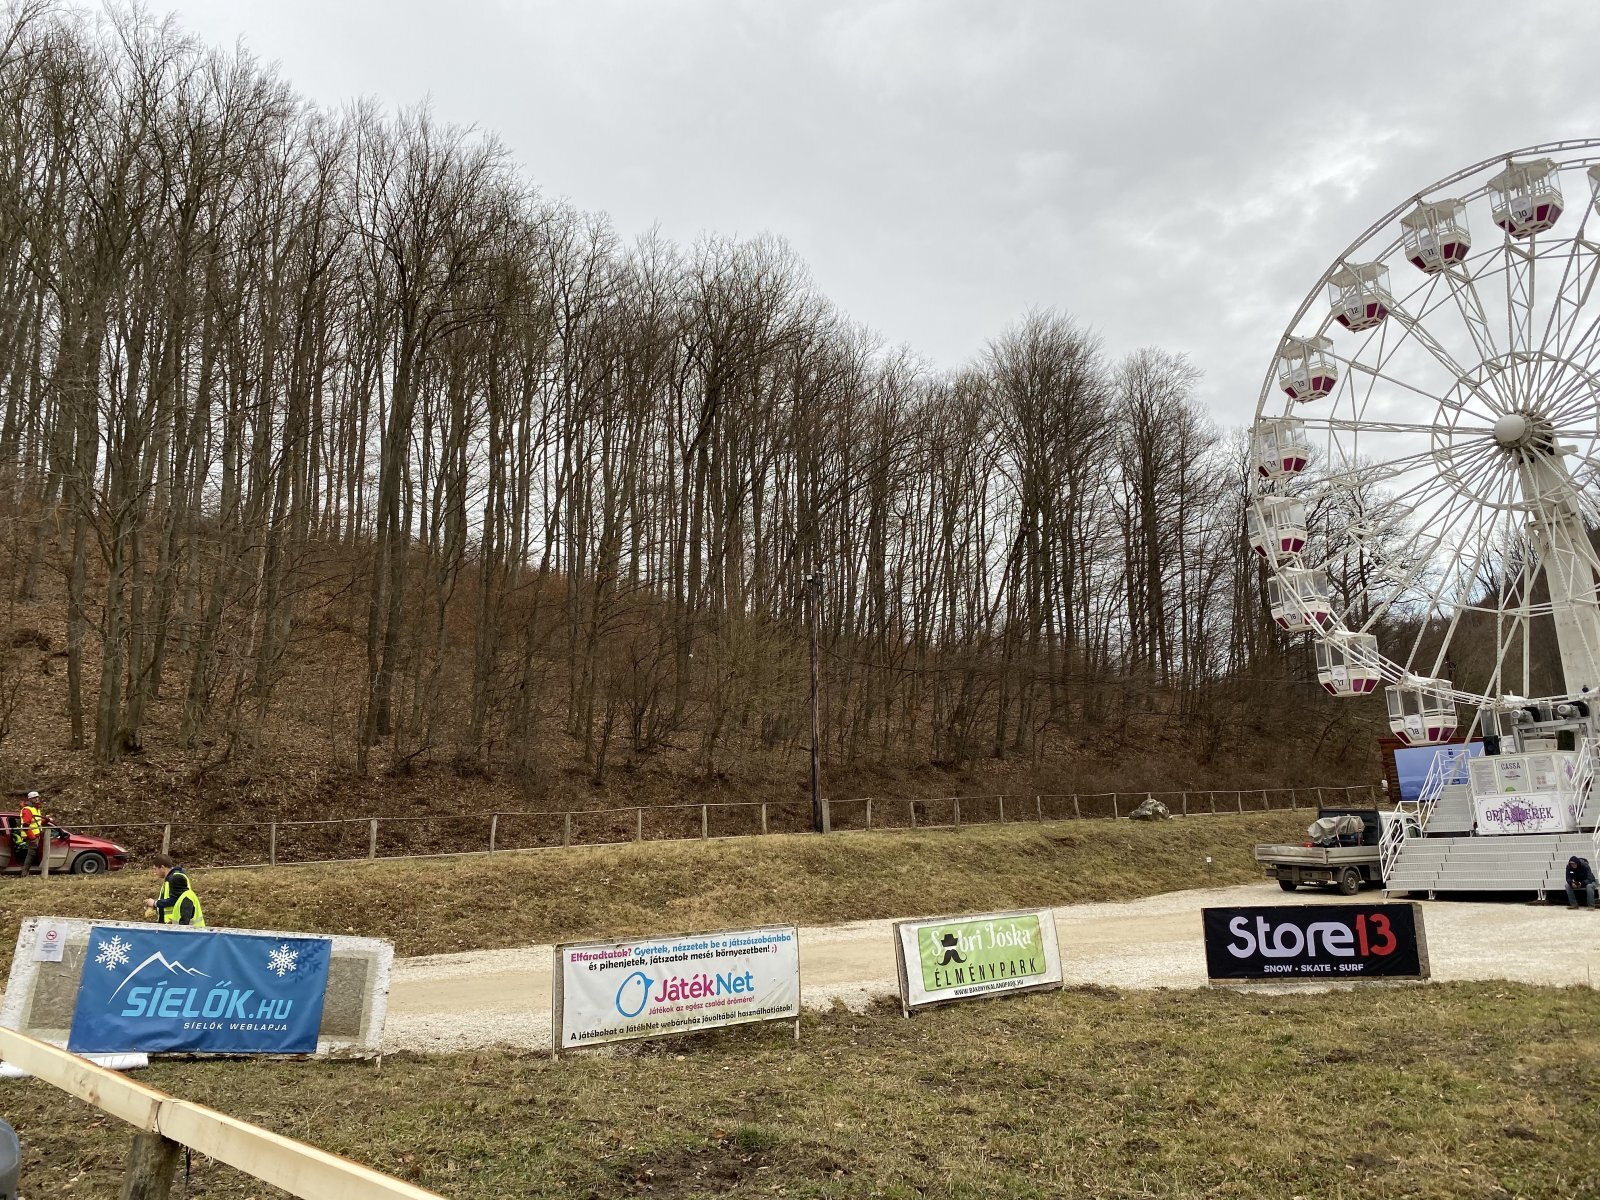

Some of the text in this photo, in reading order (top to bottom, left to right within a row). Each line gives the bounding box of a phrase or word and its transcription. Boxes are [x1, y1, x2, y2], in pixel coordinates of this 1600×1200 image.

[1519, 209, 1528, 217] 10
[1351, 306, 1359, 314] 12
[1501, 762, 1521, 770] CASSA
[570, 948, 632, 962] Elfáradtatok?
[634, 944, 671, 956] Gyertek,
[672, 941, 709, 952] nézzetek
[710, 940, 720, 949] be
[729, 934, 791, 948] játszószobánkba
[930, 922, 1032, 957] Sbri Jóska
[1226, 913, 1397, 958] Store13
[588, 962, 597, 971] és
[599, 957, 648, 971] pihenjetek,
[649, 952, 688, 965] játszatok
[690, 950, 713, 960] mesés
[715, 944, 770, 958] környezetben!
[1263, 963, 1364, 973] SNOW SKATE SURF
[934, 957, 1037, 987] ÉLMÉNYPARK
[121, 980, 293, 1020] SÍELŐK.HU
[654, 970, 755, 1003] JátékNet
[648, 1005, 674, 1016] Játékok
[685, 1002, 704, 1012] egész
[704, 999, 725, 1008] család
[183, 1020, 288, 1031] SÍELŐK WEBLAPJA
[570, 1032, 577, 1040] A
[579, 1027, 617, 1040] játékokat
[626, 1021, 659, 1033] JátékNet
[660, 1017, 701, 1028] webáruház
[701, 1012, 737, 1023] jóvoltából
[737, 1004, 793, 1018] használhatjátok!
